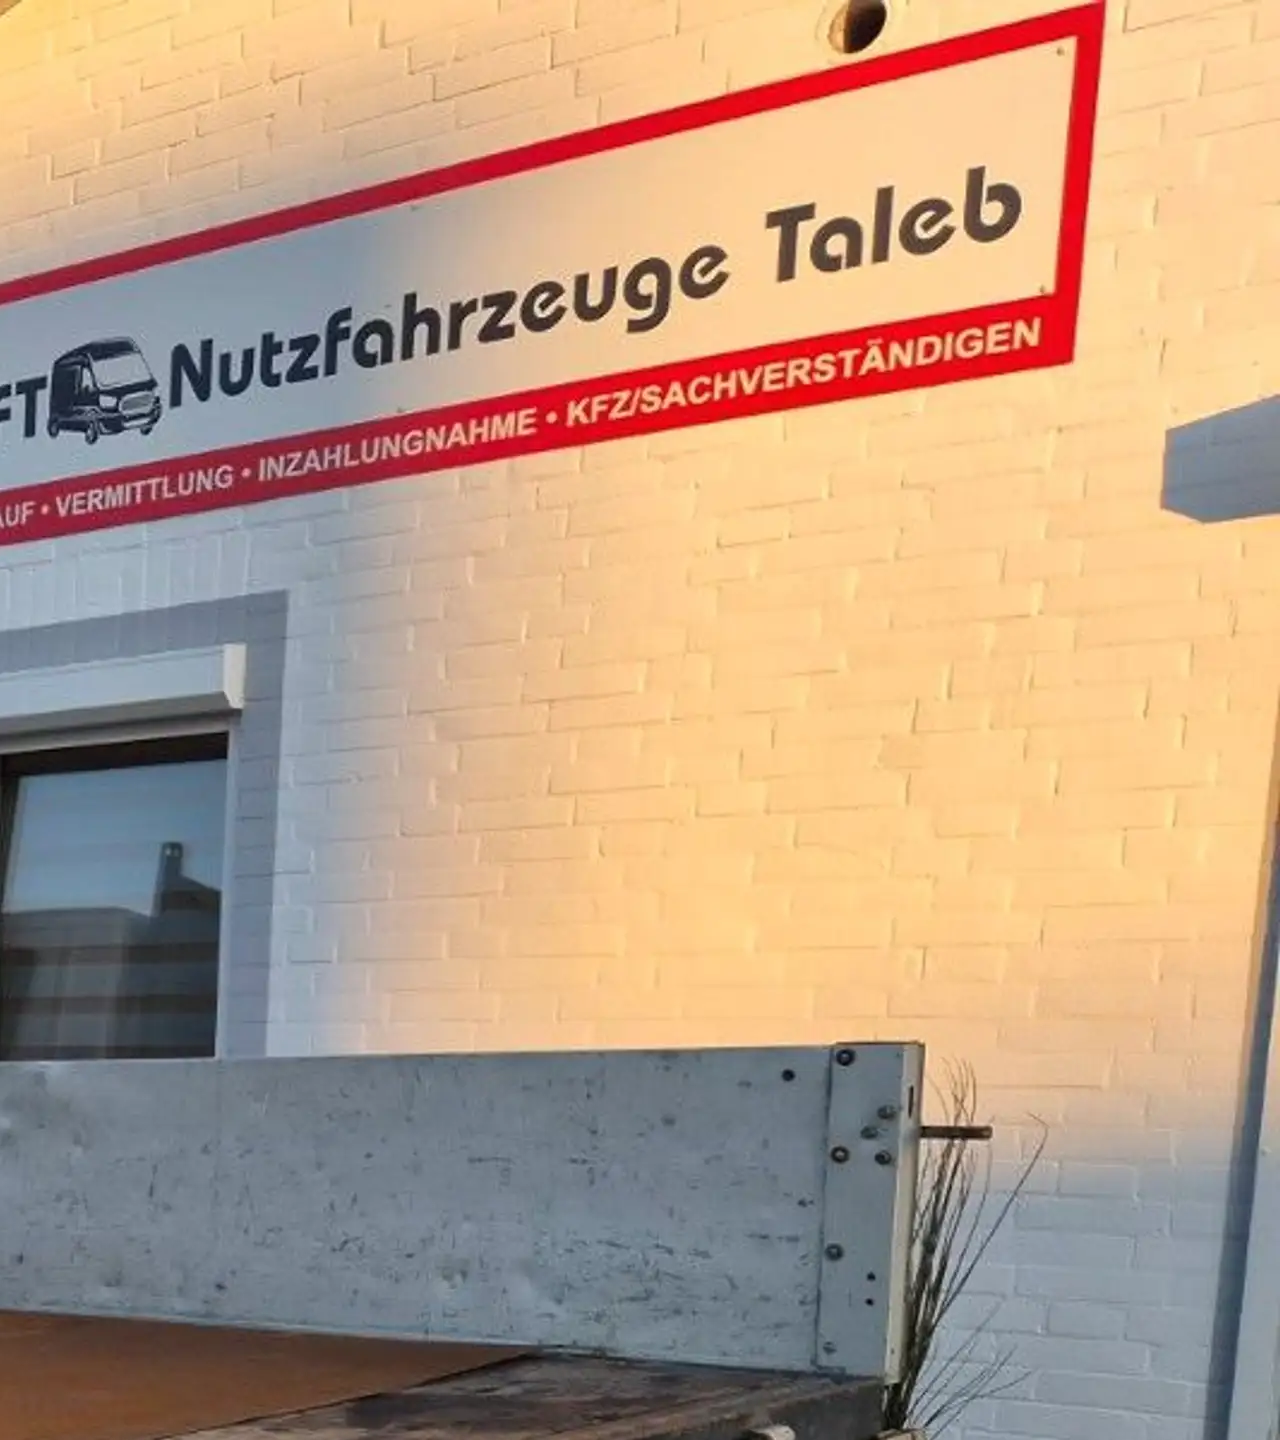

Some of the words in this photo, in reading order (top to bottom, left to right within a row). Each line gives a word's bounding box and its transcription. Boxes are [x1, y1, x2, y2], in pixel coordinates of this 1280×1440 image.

[169, 245, 730, 408] Nutzfahrzeuge
[766, 166, 1022, 282] Taleb
[55, 465, 234, 517] VERMITTLUNG
[258, 407, 538, 481] INZAHLUNGNAHME
[566, 317, 1042, 427] KFZ/SACHVERSTÄNDIGEN
